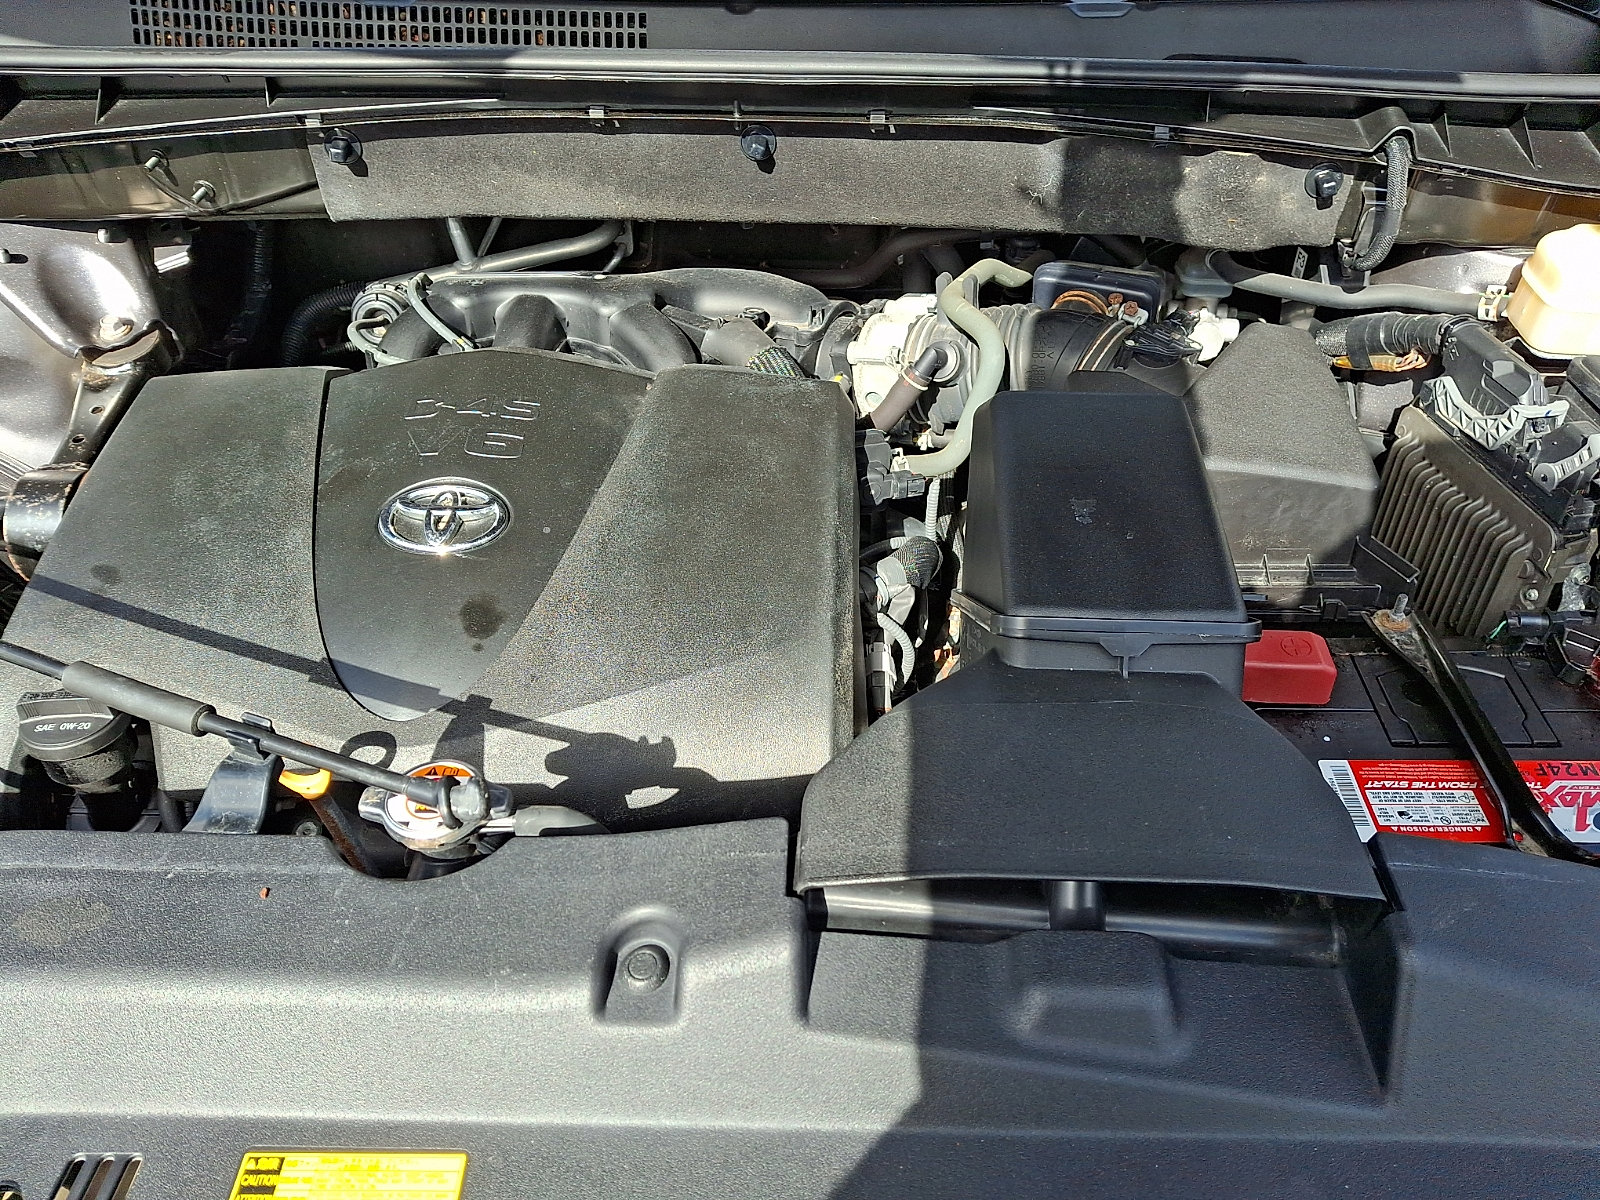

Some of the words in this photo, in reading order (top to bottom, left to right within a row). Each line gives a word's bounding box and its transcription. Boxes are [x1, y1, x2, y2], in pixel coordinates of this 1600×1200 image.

[407, 428, 525, 459] V6
[33, 723, 56, 733] SAE
[59, 722, 91, 731] 0W-20
[1534, 762, 1600, 776] M24F
[240, 1174, 279, 1187] CAUTION
